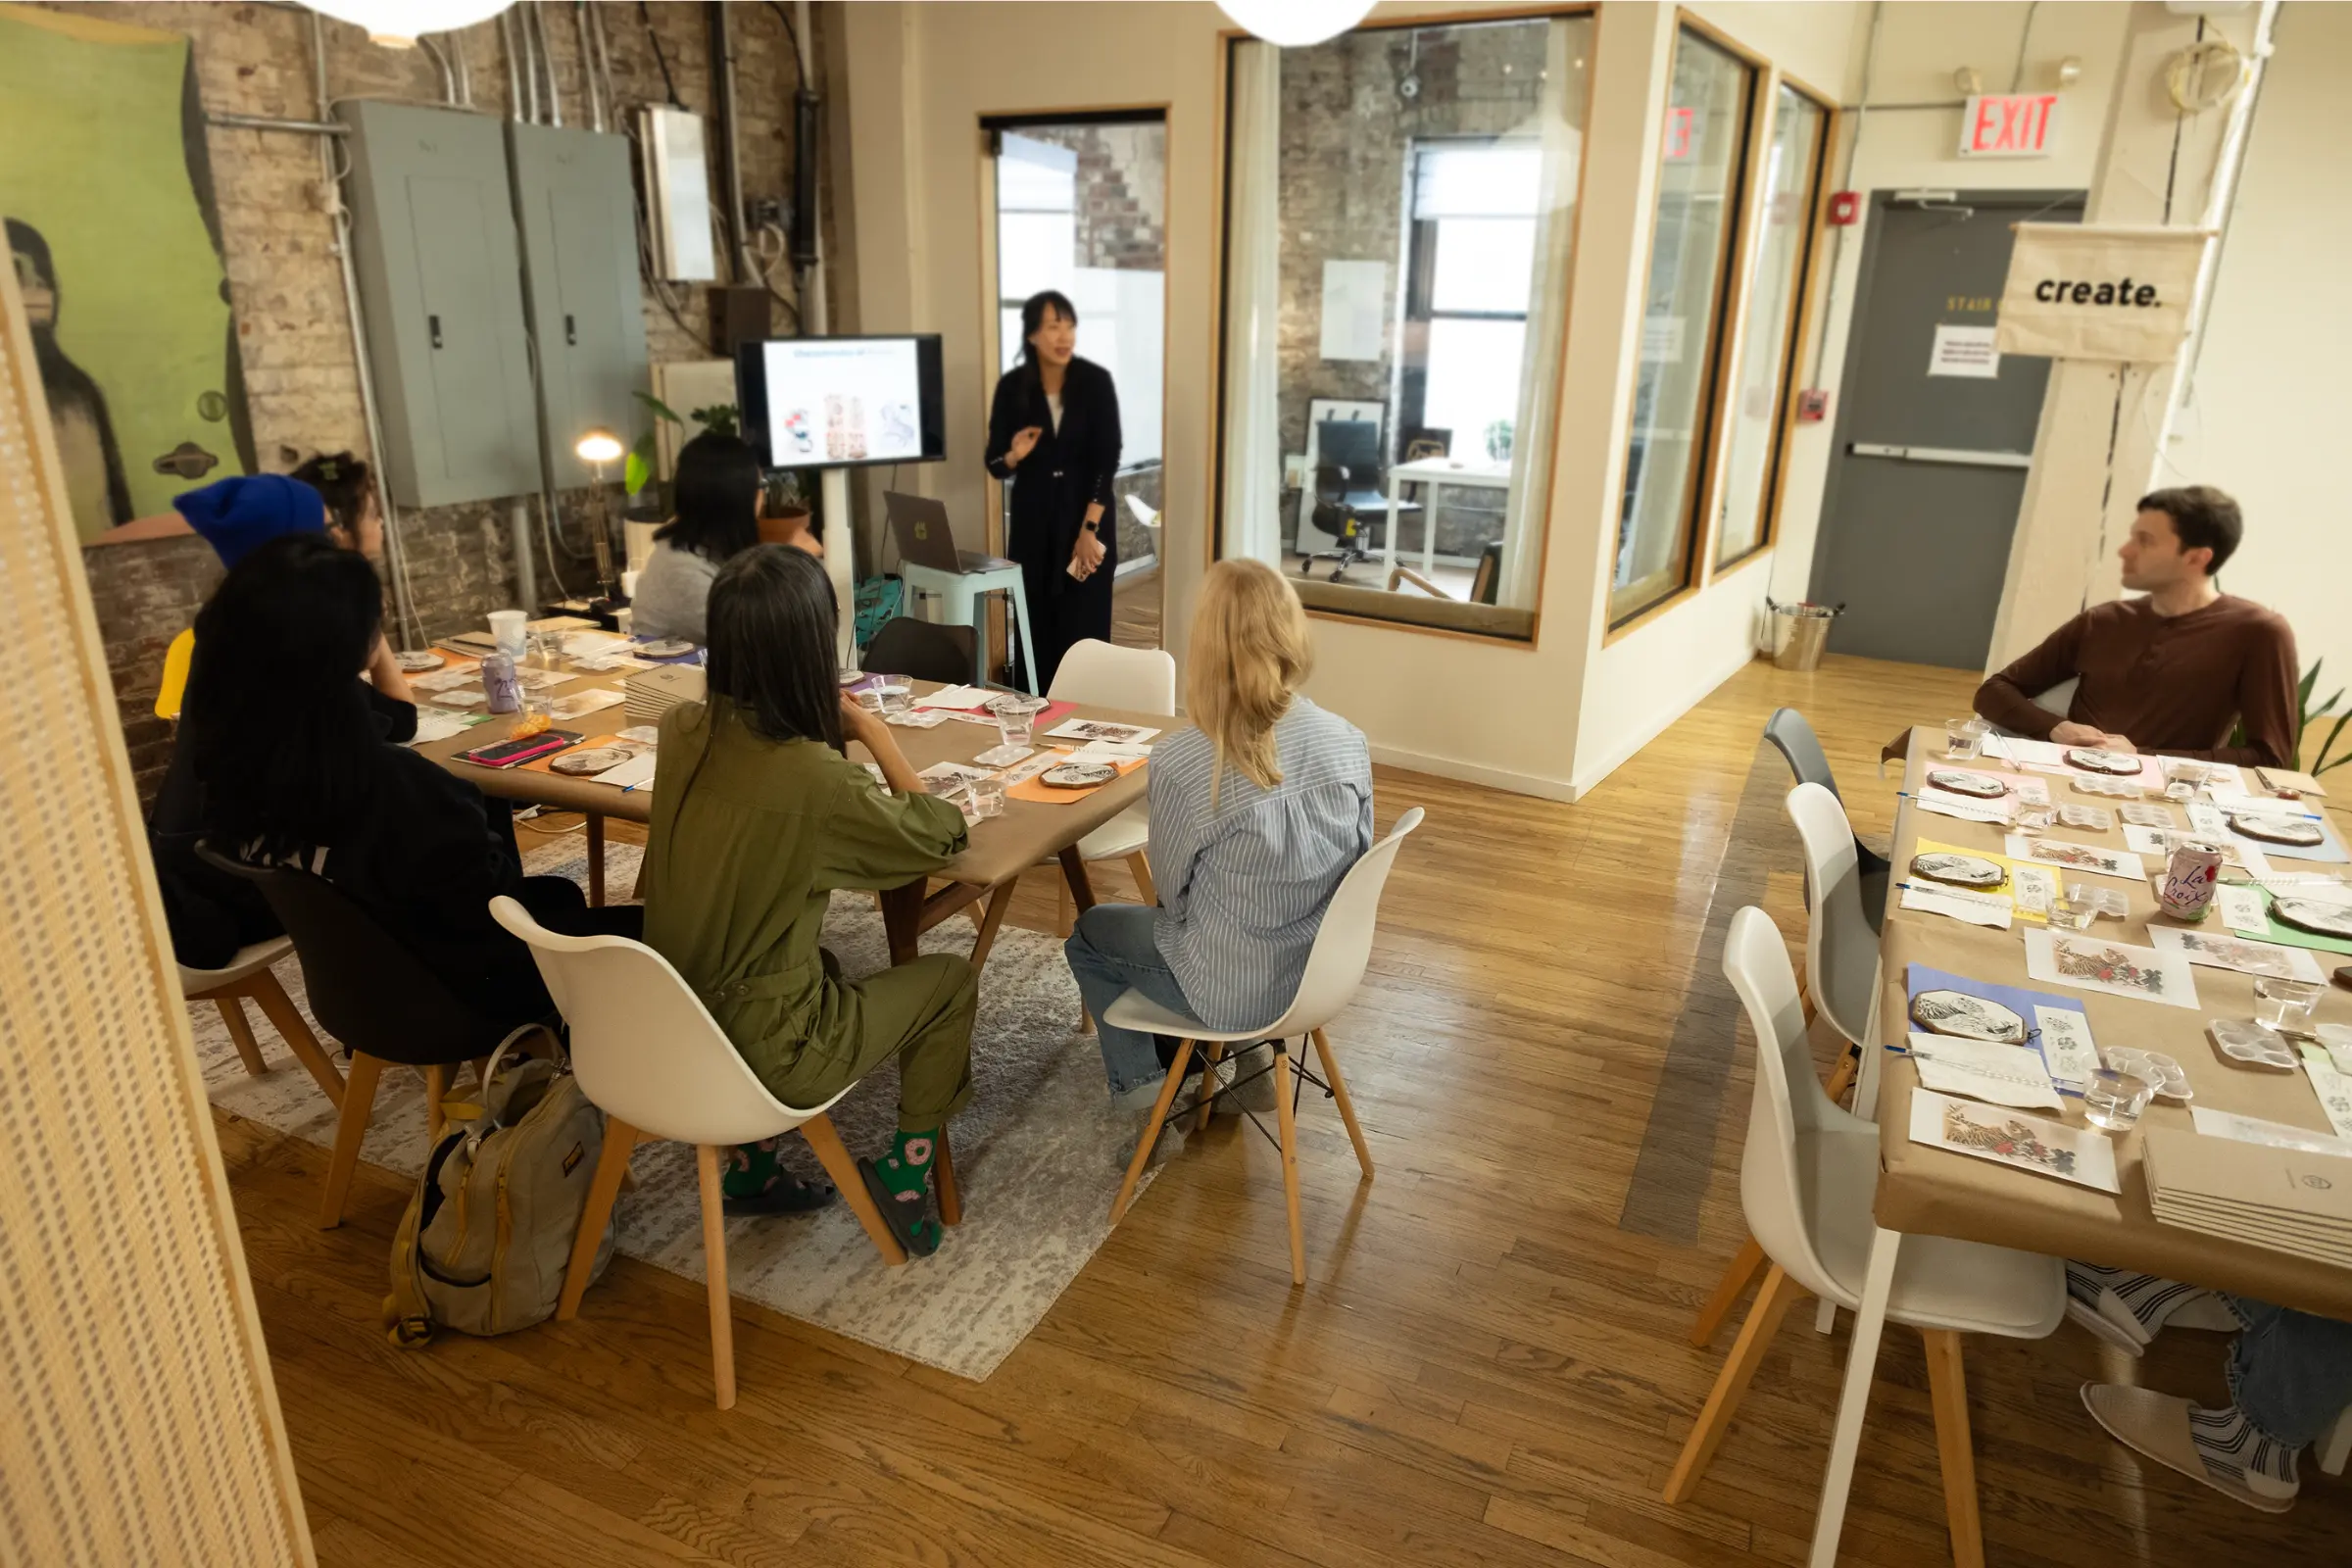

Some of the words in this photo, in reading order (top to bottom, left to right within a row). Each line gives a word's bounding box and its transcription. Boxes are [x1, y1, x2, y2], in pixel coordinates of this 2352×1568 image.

[1972, 95, 2057, 151] EXIT
[2035, 277, 2162, 308] create.
[2180, 865, 2204, 889] La
